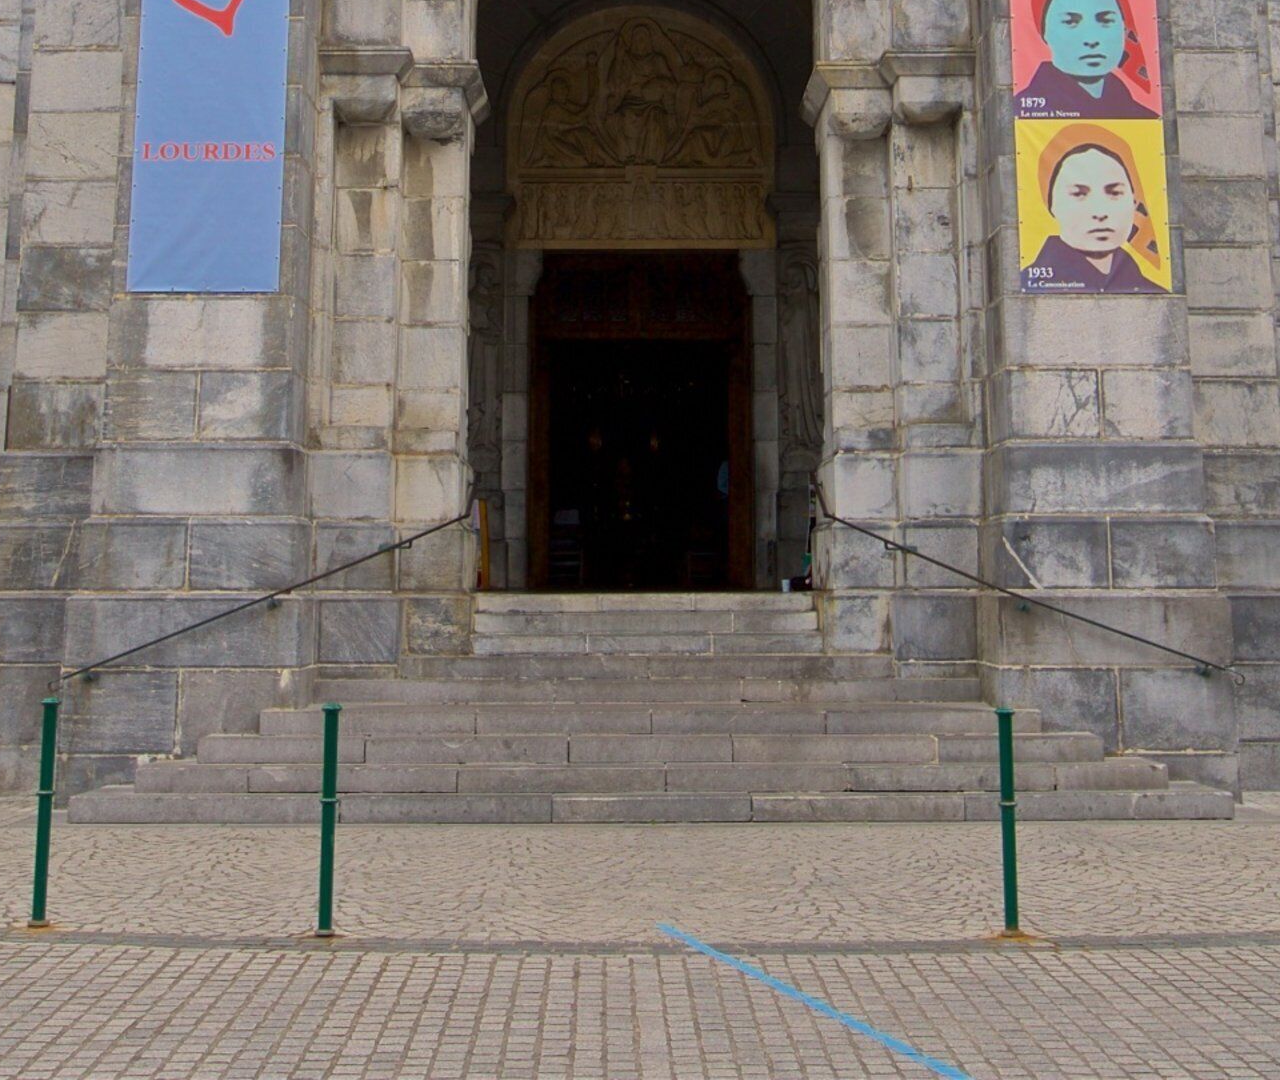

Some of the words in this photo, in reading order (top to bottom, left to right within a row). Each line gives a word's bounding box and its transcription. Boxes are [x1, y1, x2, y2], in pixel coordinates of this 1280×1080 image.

[1020, 97, 1047, 108] 1879
[142, 141, 276, 161] LOURDES
[1028, 267, 1054, 279] 1933
